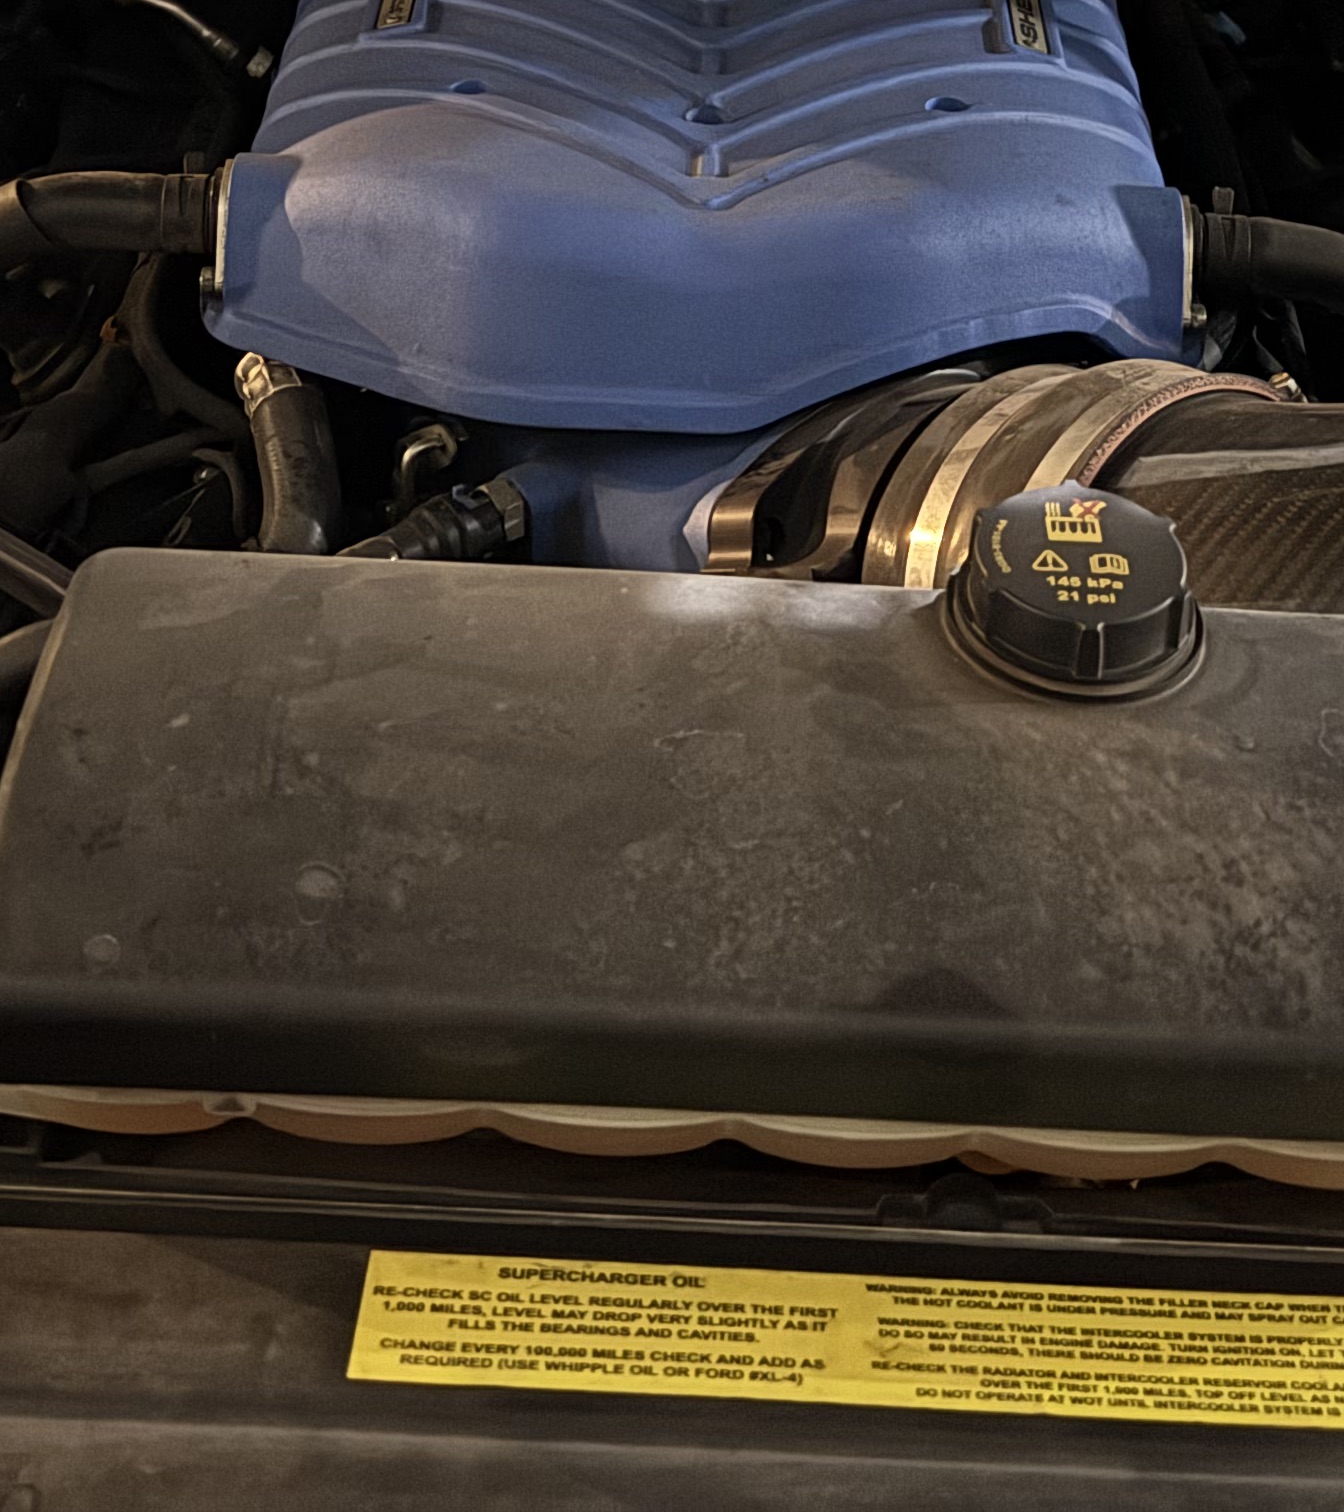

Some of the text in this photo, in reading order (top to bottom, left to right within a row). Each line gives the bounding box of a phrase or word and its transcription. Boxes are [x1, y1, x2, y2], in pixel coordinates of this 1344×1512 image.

[1046, 576, 1124, 589] 145 kPa
[1057, 591, 1116, 605] 21 psi
[499, 1267, 705, 1288] SUPERCHARGER OIL
[374, 1286, 838, 1318] RE-CHECK SC OIL LEVEL REGULARLY OVER THE FIRST
[385, 1301, 828, 1331] 1,000 MILES, LEVEL MAY DROP VERY SLIGHTLY AS IT
[449, 1319, 759, 1342] FILLS THE BEARINGS AND CAVITIES.
[381, 1339, 456, 1352] CHANGE
[461, 1343, 520, 1354] EVERY
[592, 1349, 645, 1360] MILES
[650, 1351, 712, 1363] CHECK
[716, 1355, 754, 1365] AND
[758, 1356, 796, 1368] ADD
[800, 1359, 826, 1370] AS
[401, 1355, 493, 1368] REQUIRED
[498, 1359, 539, 1370] (USE
[545, 1361, 624, 1374] WHIPPLE
[629, 1365, 658, 1376] OIL
[663, 1367, 689, 1376] OR
[695, 1368, 744, 1379] FORD
